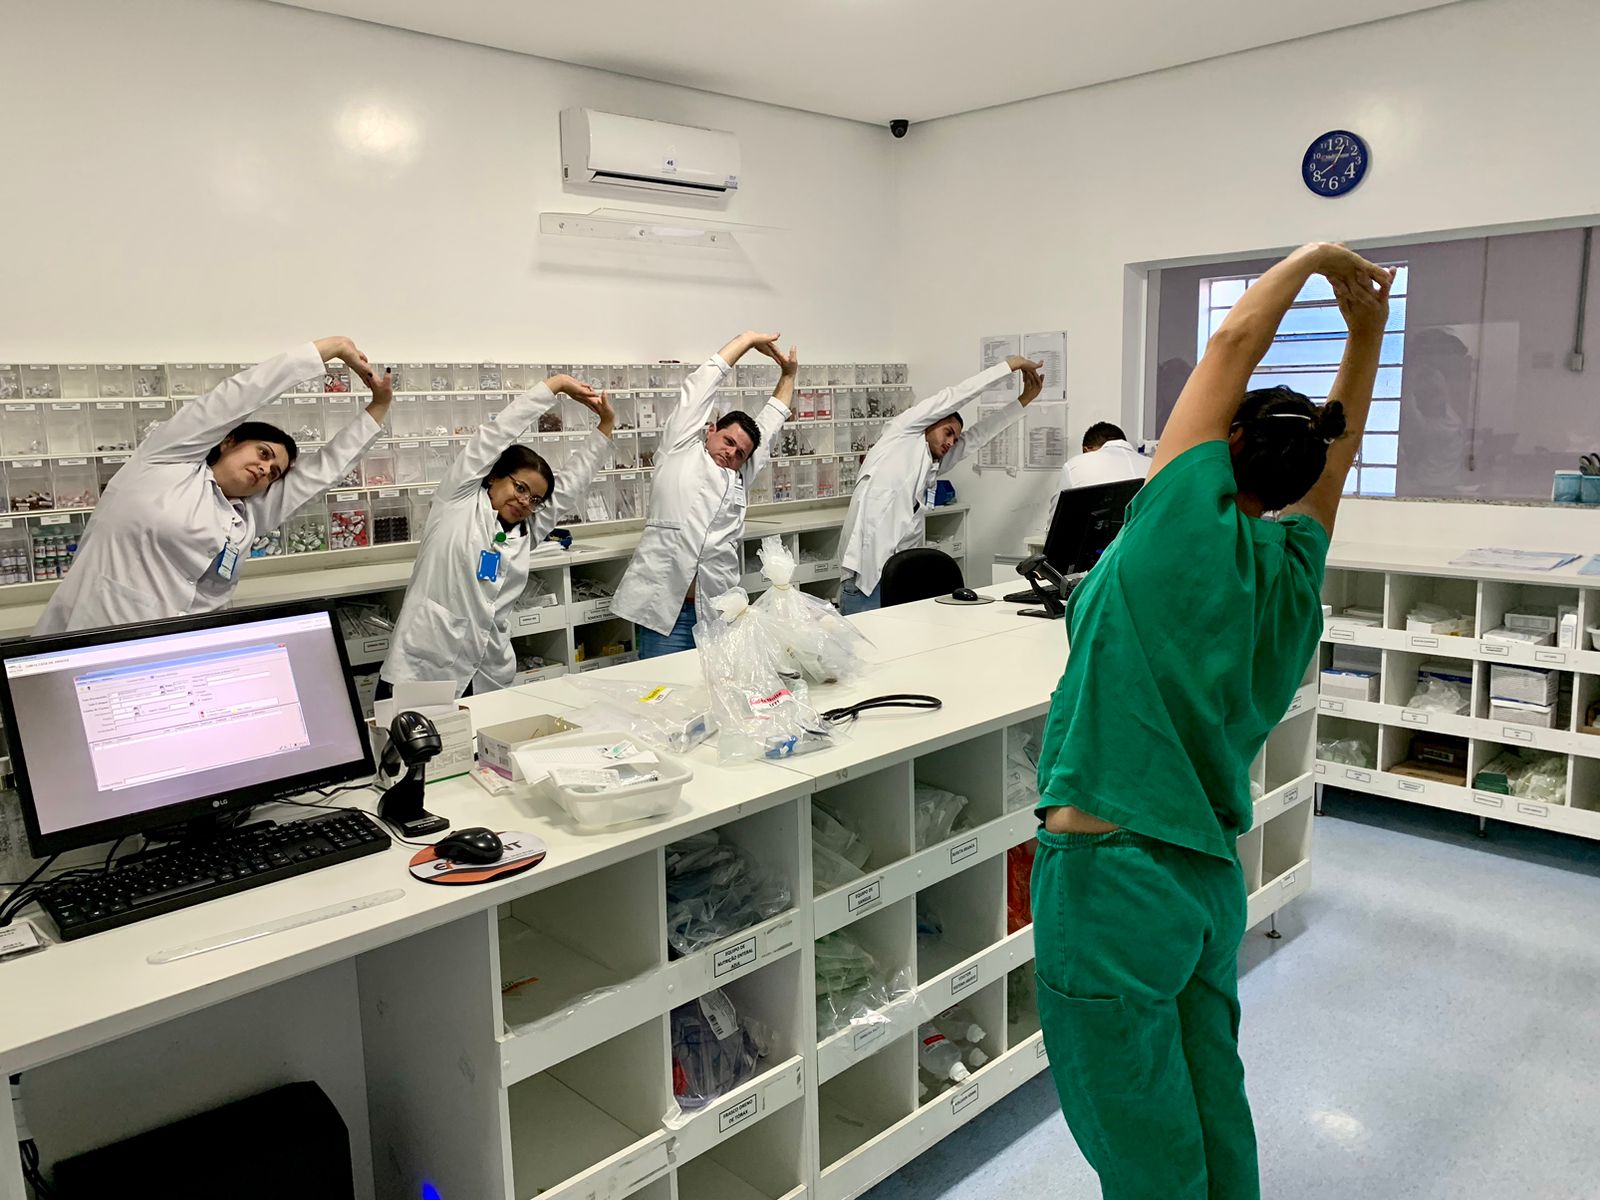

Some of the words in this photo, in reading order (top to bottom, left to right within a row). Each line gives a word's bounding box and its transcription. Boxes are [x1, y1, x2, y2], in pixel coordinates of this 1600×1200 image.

[1327, 137, 1344, 151] 12
[1313, 152, 1321, 160] 10
[1350, 145, 1358, 156] 2
[1355, 156, 1361, 165] 3
[1309, 162, 1316, 171] 9
[1344, 162, 1356, 179] 4
[1312, 170, 1321, 182] 8
[1320, 178, 1326, 188] 7
[1328, 176, 1339, 190] 6
[724, 946, 740, 956] EQUIPO
[717, 955, 737, 967] NUTRIÇÃO
[723, 1107, 738, 1119] FRASCO
[728, 1116, 734, 1124] DE
